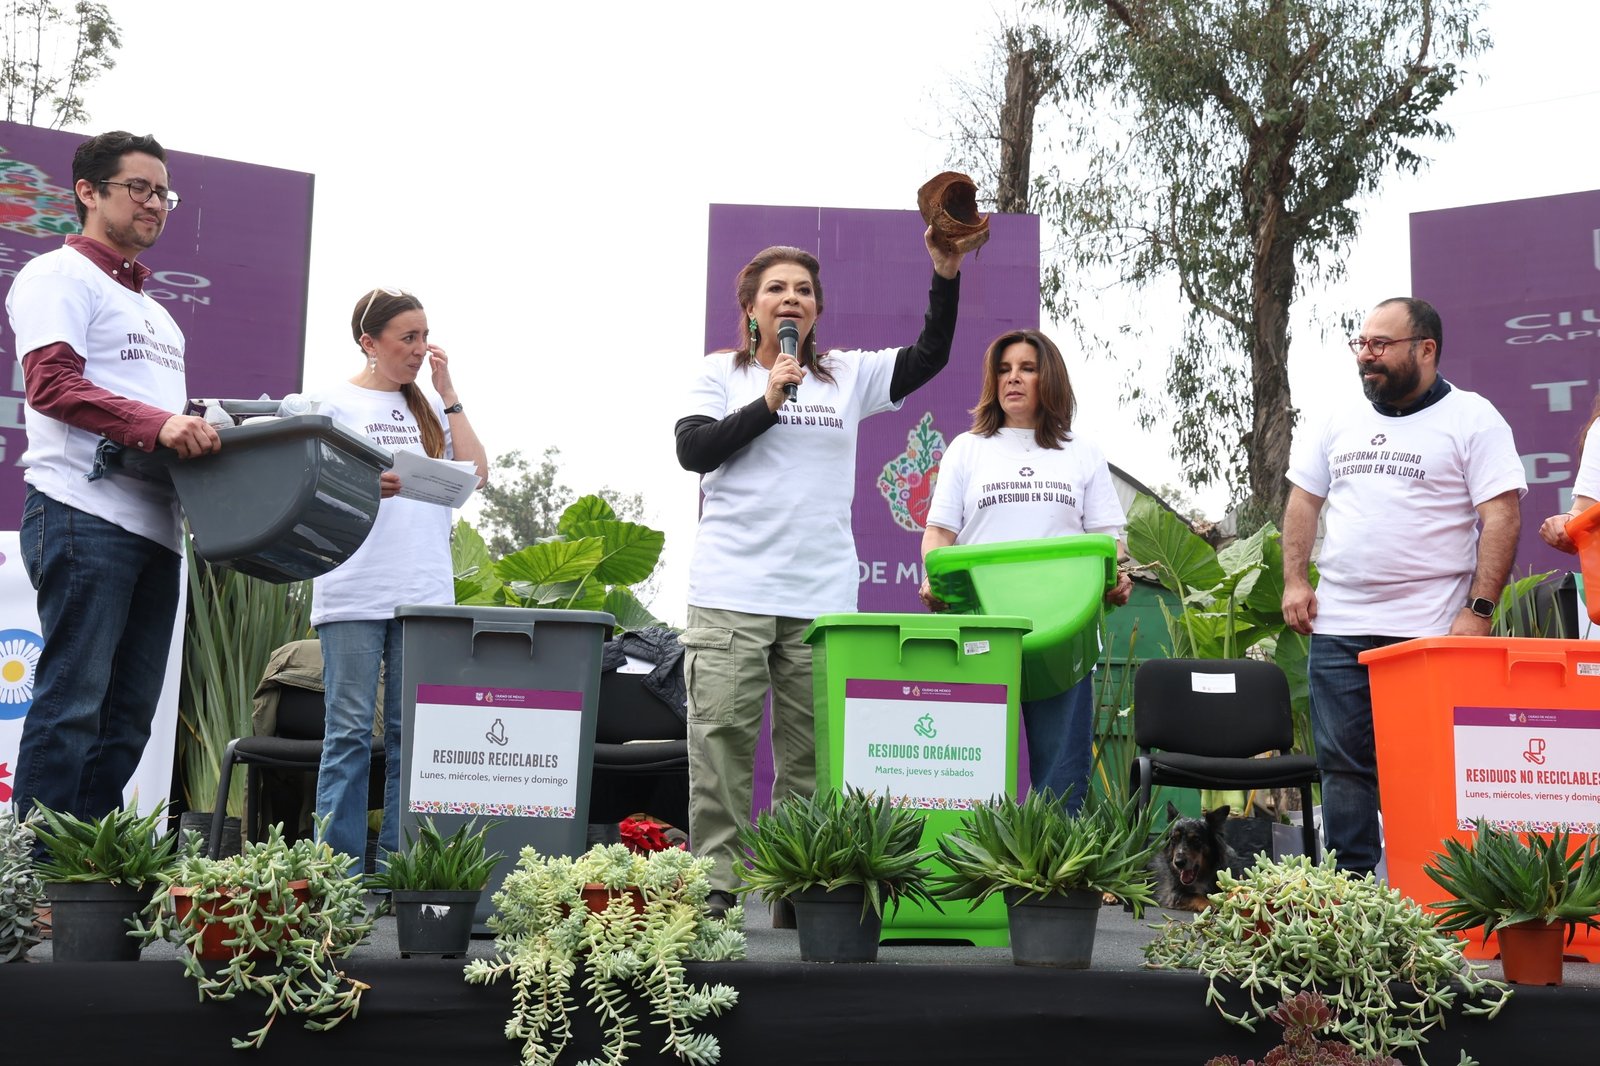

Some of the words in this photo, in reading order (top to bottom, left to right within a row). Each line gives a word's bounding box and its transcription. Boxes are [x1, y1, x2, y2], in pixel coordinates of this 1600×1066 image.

[120, 349, 145, 360] CADA
[791, 404, 803, 413] TU
[804, 404, 836, 414] CIUDAD
[364, 423, 407, 434] TRANSFORMA
[407, 425, 417, 433] TU
[791, 415, 802, 425] EN
[804, 416, 816, 426] SU
[819, 416, 844, 430] LUGAR
[382, 435, 409, 445] RESIDUO
[409, 435, 419, 444] EN
[1333, 451, 1378, 465] TRANSFORMA
[1380, 451, 1391, 460] TU
[1391, 451, 1422, 465] CIUDAD
[1341, 464, 1373, 476] RESIDUO
[1373, 464, 1385, 474] EN
[1386, 464, 1397, 475] SU
[1399, 466, 1426, 480] LUGAR
[982, 481, 1032, 494] TRANSFORMA
[1034, 481, 1043, 489] TU
[1045, 480, 1072, 492] CIUDAD
[977, 495, 997, 510] CADA
[998, 493, 1030, 504] RESIDUO
[1032, 492, 1041, 502] EN
[1043, 492, 1054, 502] SU
[1055, 492, 1077, 508] LUGAR
[858, 561, 887, 584] DE
[868, 743, 920, 759] RESIDUOS
[923, 744, 982, 761] ORGÁNICOS
[433, 750, 485, 765] RESIDUOS
[488, 752, 558, 769] RECICLABLES
[875, 765, 904, 775] Martes,
[906, 766, 932, 776] jueves
[933, 768, 939, 777] y
[941, 766, 974, 777] sábados
[1466, 768, 1516, 784] RESIDUOS
[1520, 770, 1534, 784] NO
[420, 770, 446, 780] Lunes,
[448, 771, 490, 782] miércoles,
[492, 774, 522, 783] viernes
[524, 777, 530, 785] y
[531, 774, 568, 787] domingo
[1465, 790, 1491, 799] Lunes,
[1493, 790, 1532, 800] miércoles,
[1535, 791, 1562, 800] viernes
[1565, 794, 1570, 802] y
